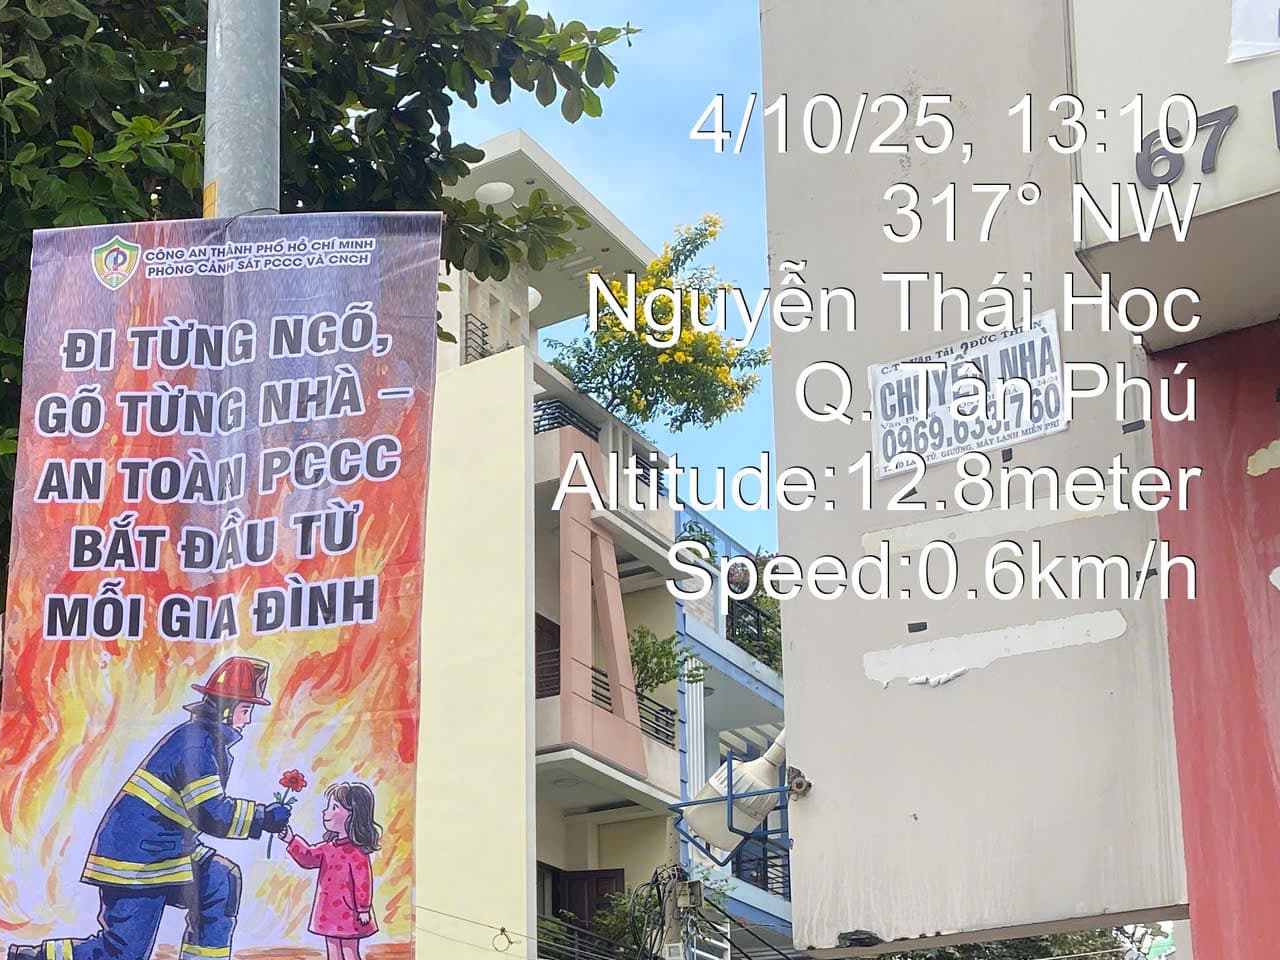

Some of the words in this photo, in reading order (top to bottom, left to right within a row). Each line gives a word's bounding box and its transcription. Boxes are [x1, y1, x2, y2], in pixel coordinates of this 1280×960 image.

[1136, 104, 1238, 190] 67
[145, 249, 185, 262] CÔNG
[188, 249, 207, 259] AN
[211, 243, 252, 257] THÀNH
[257, 240, 284, 255] PHỐ
[311, 239, 335, 251] CHÍ
[339, 240, 373, 250] MINH
[148, 264, 194, 277] PHÒNG
[198, 260, 234, 274] CẢNH
[237, 257, 261, 270] SÁT
[264, 257, 303, 268] PCCC
[307, 254, 325, 266] VÀ
[329, 254, 369, 265] CNCH
[61, 330, 114, 369] ĐI
[130, 317, 253, 369] TỪNG
[271, 302, 392, 358] NGÕ,
[36, 386, 103, 436] GÕ
[119, 385, 244, 435] TỪNG
[260, 365, 365, 426] NHÀ
[36, 459, 103, 502] AN
[120, 450, 247, 502] TOÀN
[258, 436, 402, 495] PCCC
[71, 512, 166, 571] BẮT
[180, 508, 277, 571] ĐẦU
[294, 500, 362, 556] TỪ
[45, 580, 142, 639] MỖI
[161, 596, 238, 641] GIA
[253, 575, 377, 633] ĐÌNH
